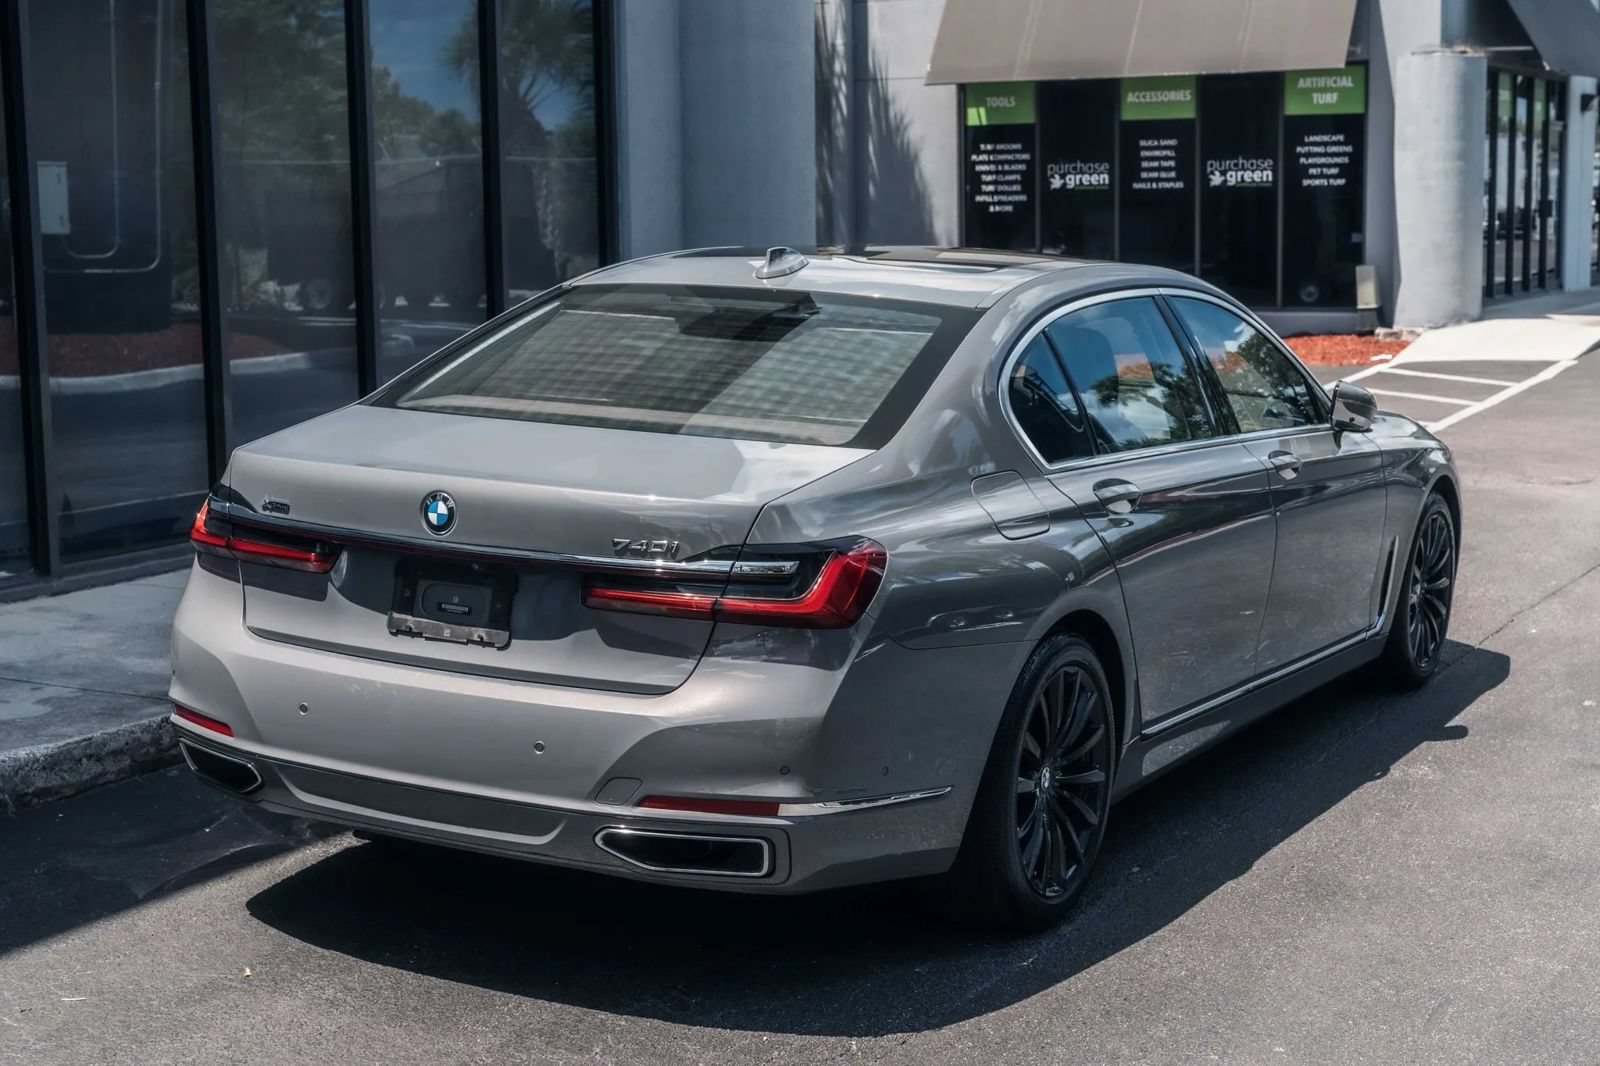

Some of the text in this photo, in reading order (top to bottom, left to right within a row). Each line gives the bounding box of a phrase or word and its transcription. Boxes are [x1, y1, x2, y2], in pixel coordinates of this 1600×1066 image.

[1298, 76, 1354, 88] ARTIFICIAL
[985, 96, 1016, 108] TOOLS
[1127, 90, 1192, 103] ACCESSORIES
[1312, 92, 1338, 104] TURF
[1326, 145, 1353, 153] GREENS
[1207, 156, 1273, 174] purchase
[1299, 156, 1349, 164] PLAYGROUNDS
[1047, 160, 1110, 177] purchase
[1066, 174, 1109, 188] green
[1226, 170, 1273, 186] green
[1302, 178, 1328, 187] SPORTS
[612, 538, 679, 554] 740i
